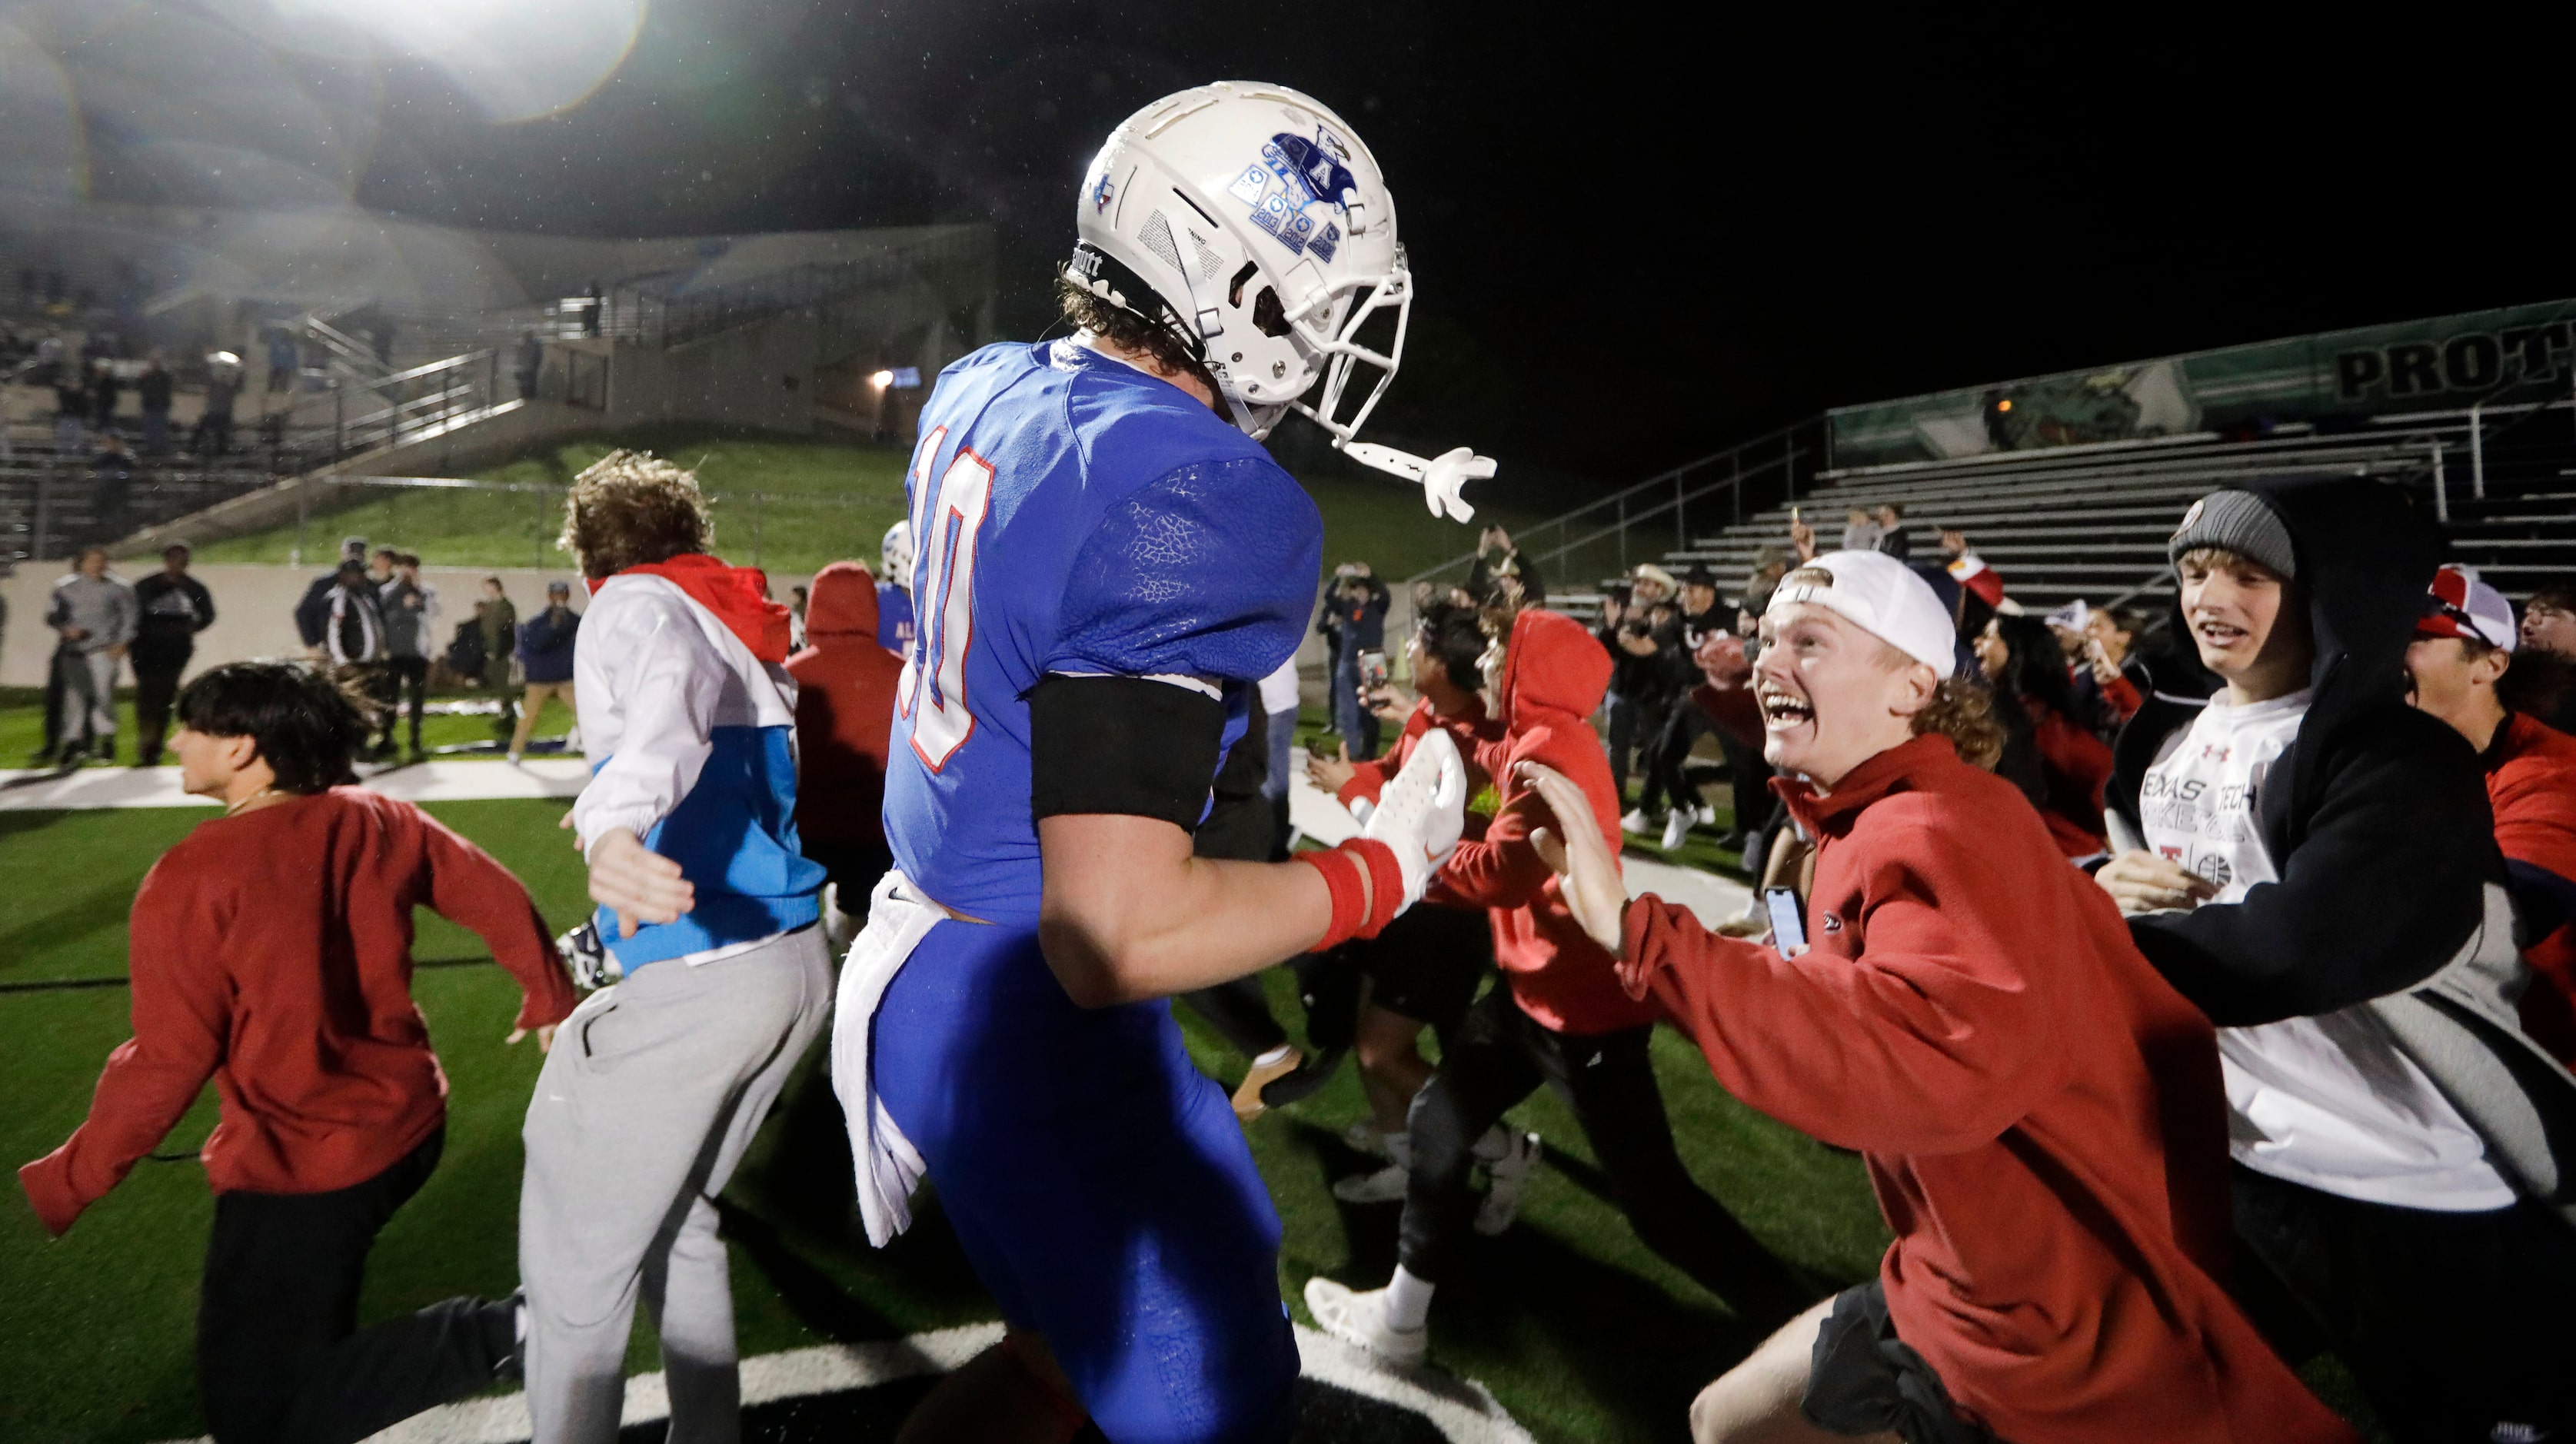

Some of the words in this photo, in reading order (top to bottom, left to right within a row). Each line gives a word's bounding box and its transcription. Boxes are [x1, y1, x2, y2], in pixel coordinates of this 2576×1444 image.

[1309, 159, 1333, 190] A
[1256, 208, 1279, 228] 2013
[1283, 228, 1306, 249] 2012
[2336, 320, 2576, 403] PROT
[898, 424, 996, 775] 10
[2143, 772, 2207, 801] EXAS
[2218, 783, 2258, 813] TECH
